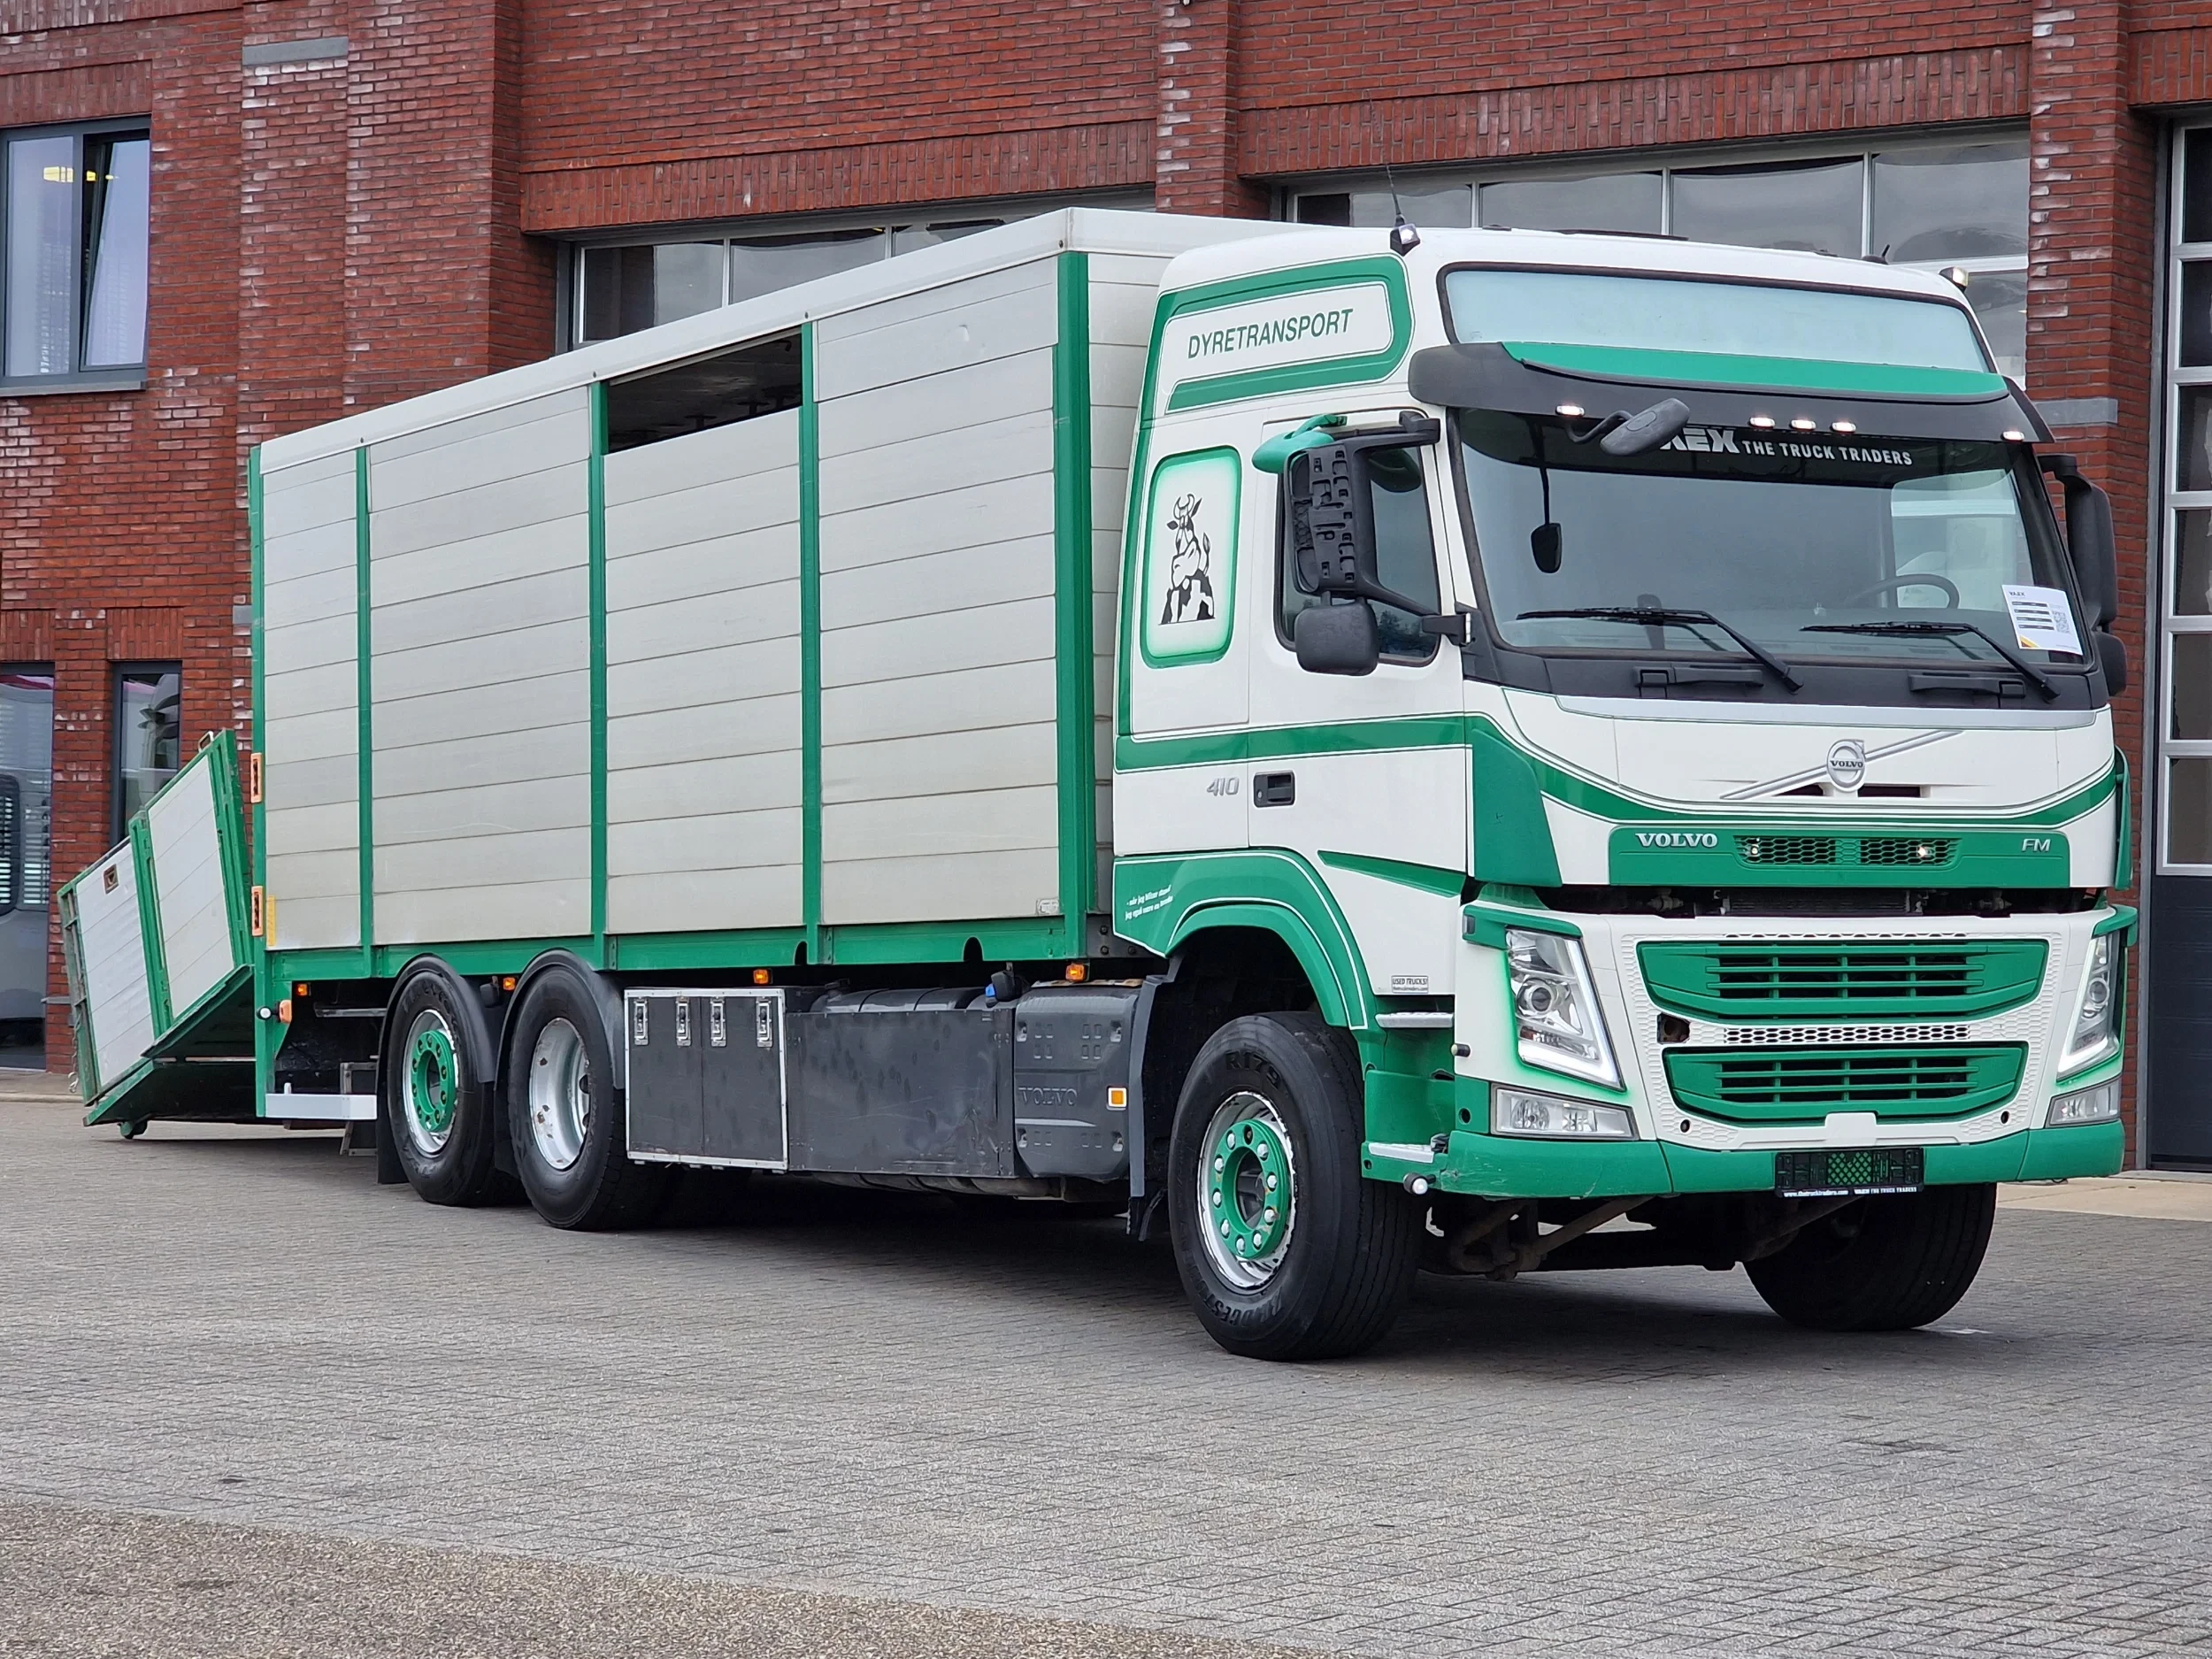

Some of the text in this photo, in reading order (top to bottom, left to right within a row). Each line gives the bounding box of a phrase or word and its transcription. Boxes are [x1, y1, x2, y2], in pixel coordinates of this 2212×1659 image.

[1187, 308, 1354, 358] DYRETRANSPORT
[1741, 440, 1776, 456] THE
[1778, 442, 1835, 460] TRUCK
[1839, 446, 1913, 465] TRADERS
[1206, 777, 1240, 797] 410
[1634, 833, 1718, 848] VOLVO
[2022, 838, 2051, 852] FM
[1225, 1050, 1281, 1090] R179
[1018, 1087, 1078, 1105] VOLVO
